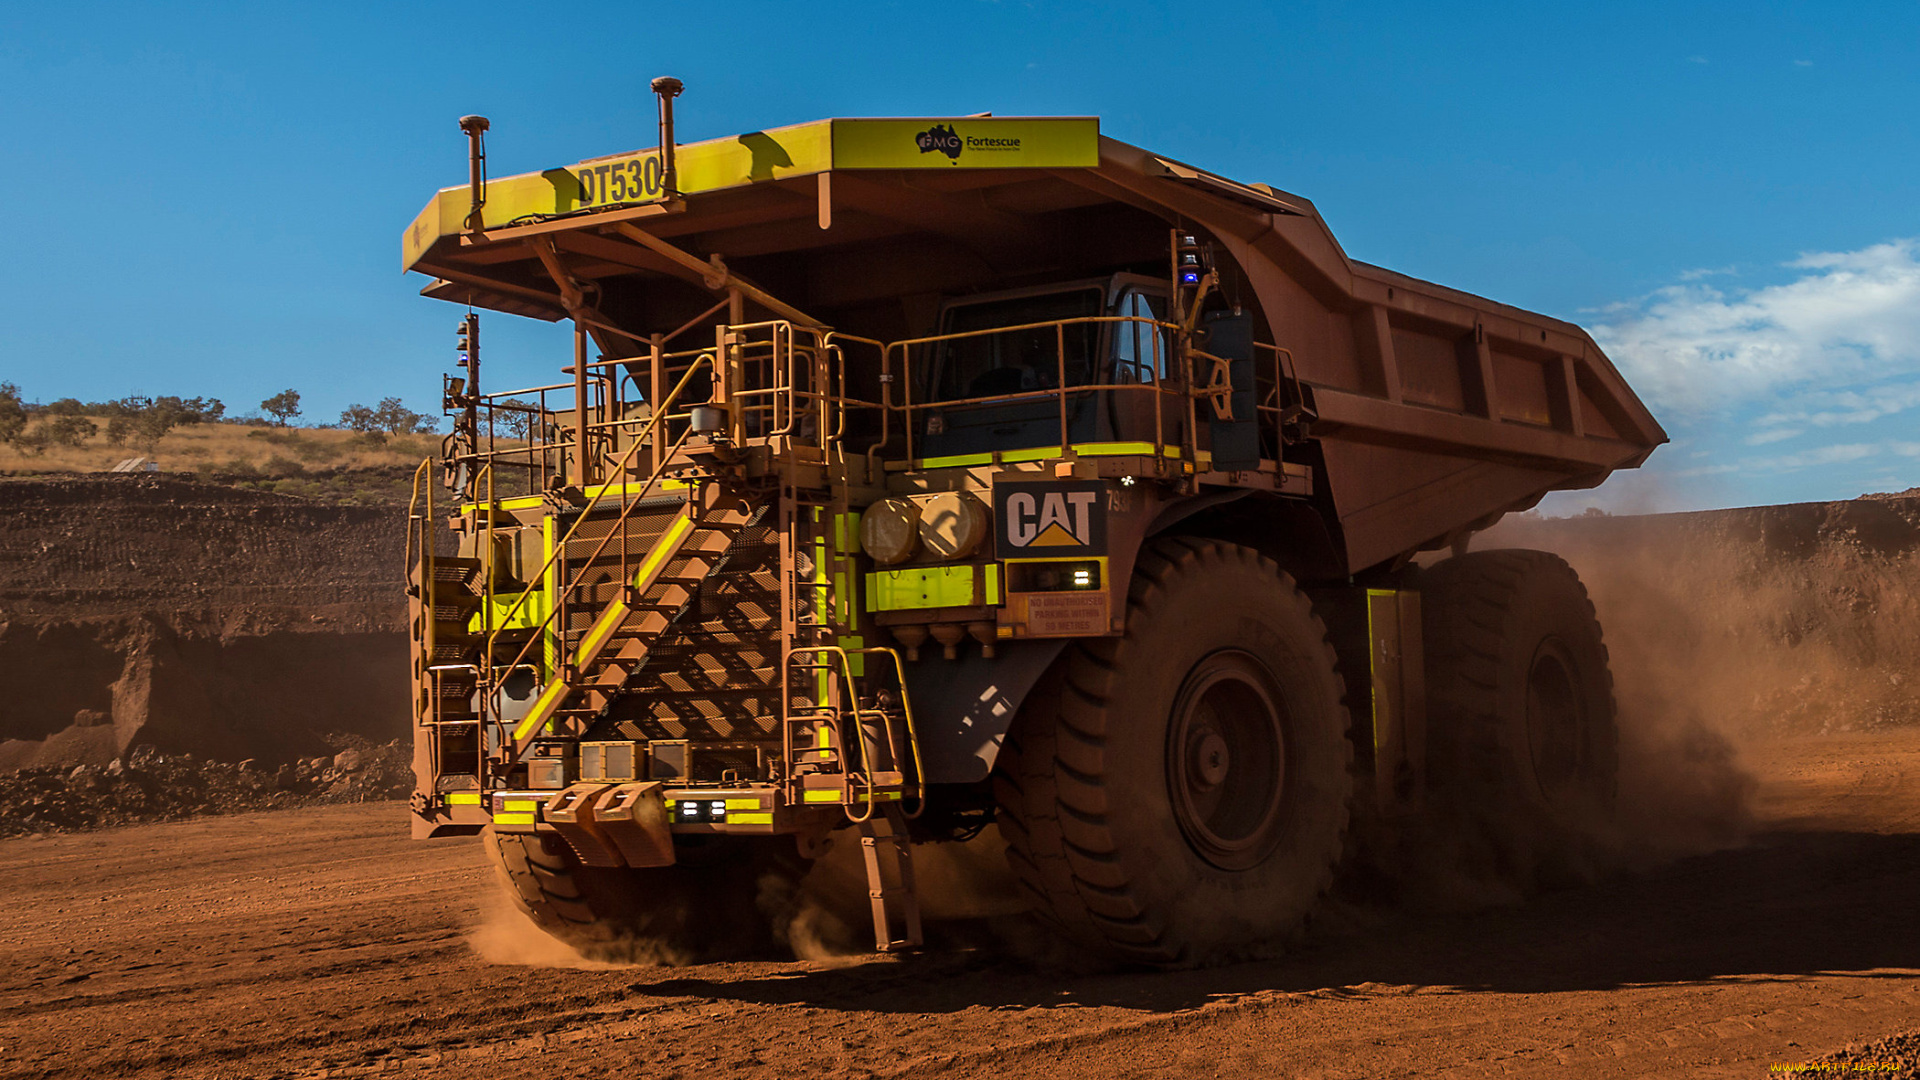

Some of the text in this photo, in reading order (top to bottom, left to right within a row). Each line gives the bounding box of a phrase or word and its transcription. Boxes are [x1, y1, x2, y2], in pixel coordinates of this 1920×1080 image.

[966, 136, 1021, 147] Fortescue
[578, 156, 661, 207] DT530
[1006, 491, 1096, 547] CAT
[1057, 621, 1090, 630] METRES
